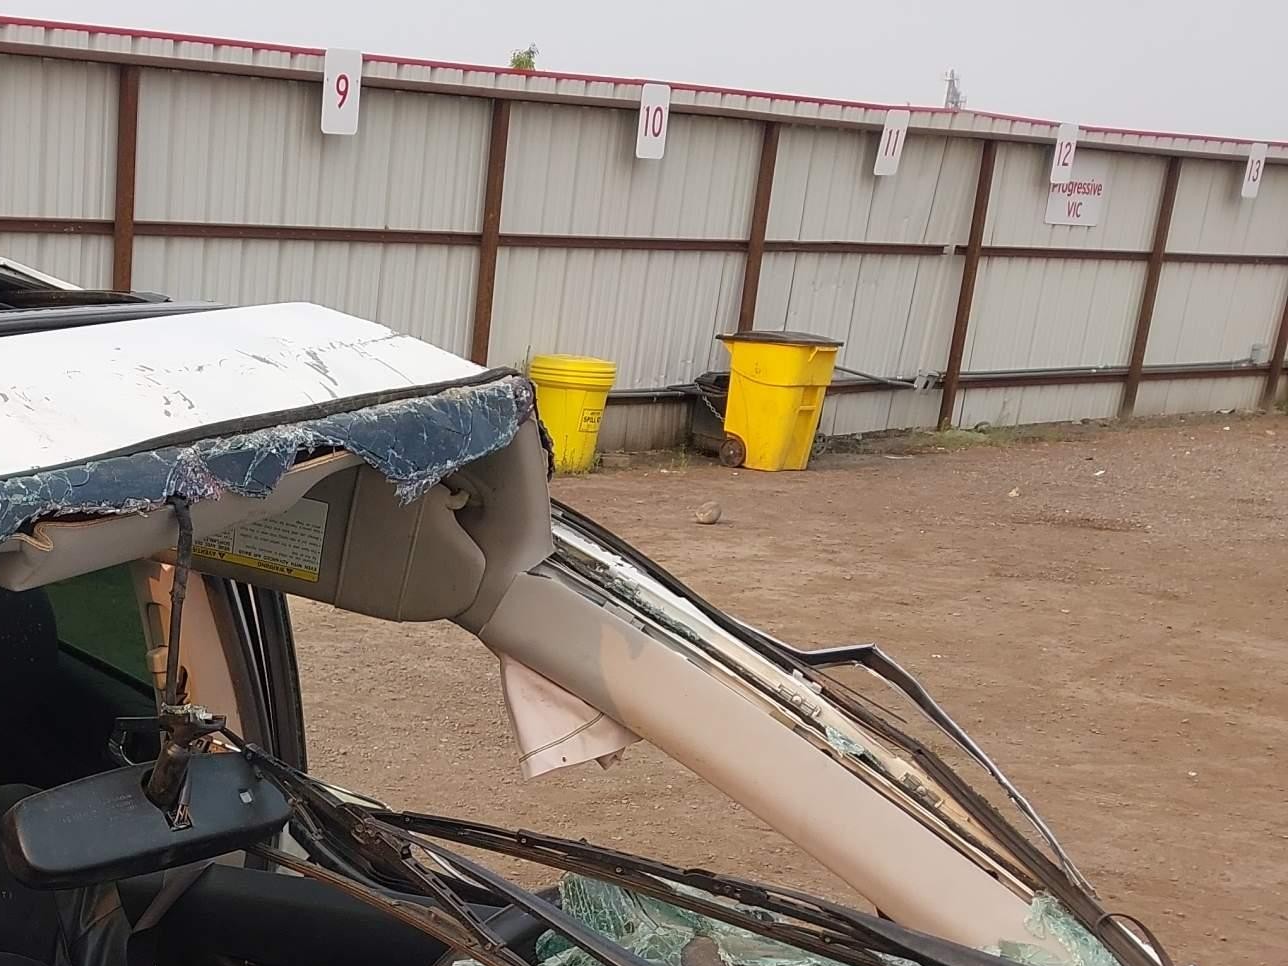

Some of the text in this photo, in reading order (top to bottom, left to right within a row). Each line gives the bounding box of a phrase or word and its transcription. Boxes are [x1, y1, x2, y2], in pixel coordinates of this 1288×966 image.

[336, 73, 349, 109] 9
[644, 105, 664, 137] 10
[884, 129, 900, 156] 11
[1056, 141, 1072, 167] 12
[1248, 159, 1261, 182] 13
[1051, 179, 1103, 196] Progressive
[1066, 201, 1083, 218] VIC
